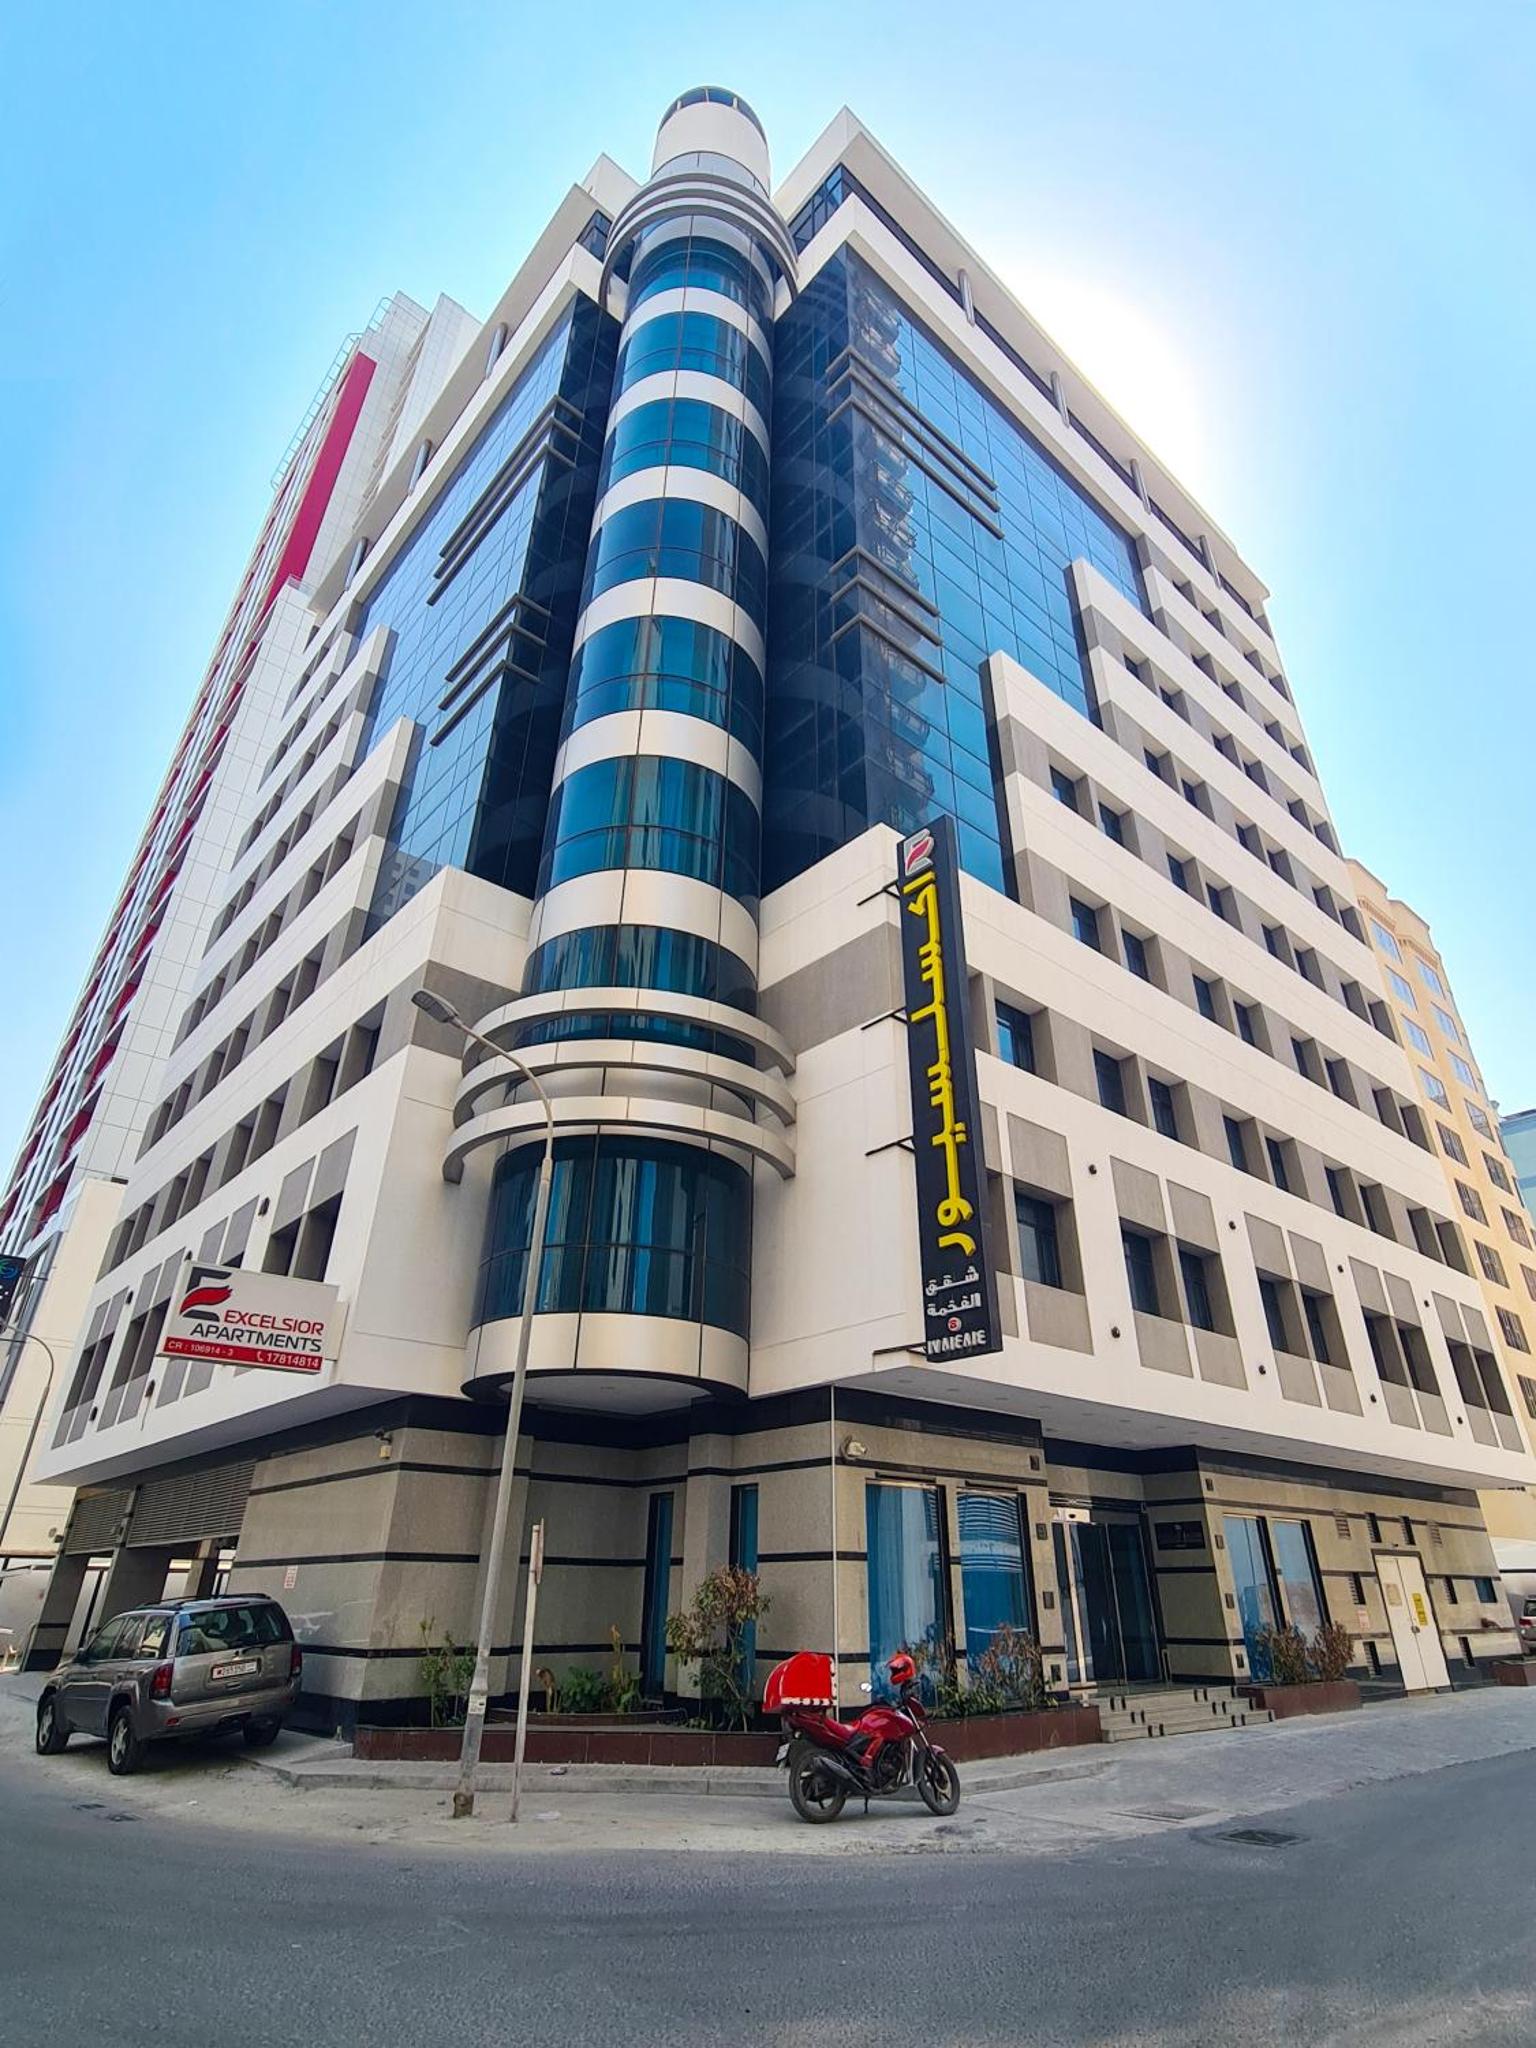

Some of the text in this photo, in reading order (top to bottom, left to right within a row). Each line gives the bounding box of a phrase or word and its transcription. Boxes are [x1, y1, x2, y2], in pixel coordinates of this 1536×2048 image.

[903, 870, 976, 1257] اكسلسيور
[925, 1265, 979, 1296] شقق
[927, 1292, 981, 1316] الفخمة
[224, 1310, 324, 1335] EXCELSIOR
[168, 1340, 183, 1350] CR
[190, 1323, 322, 1352] APARTMENTS
[266, 1352, 320, 1368] 17814814
